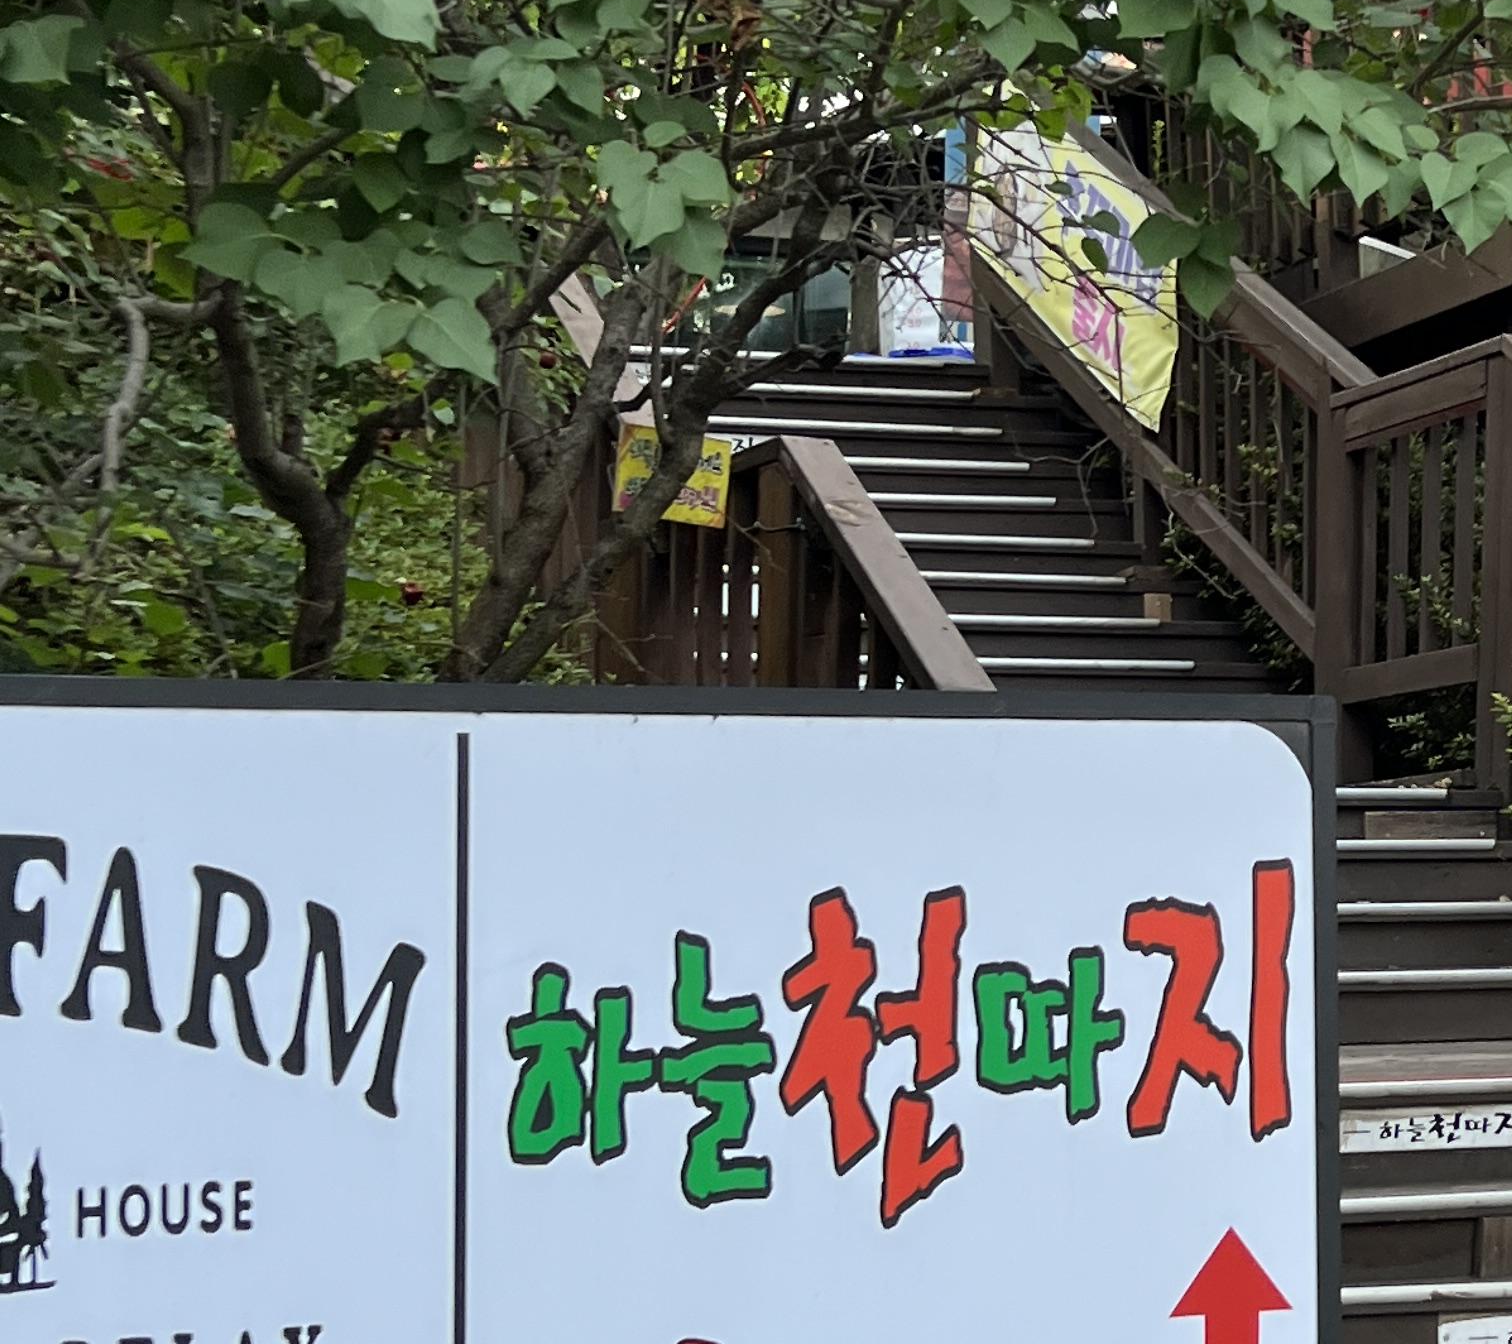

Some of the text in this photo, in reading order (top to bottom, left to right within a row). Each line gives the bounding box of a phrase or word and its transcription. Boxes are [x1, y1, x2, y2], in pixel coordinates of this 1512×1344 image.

[0, 833, 427, 1119] FARM
[506, 858, 1295, 1228] 하늘천따지
[77, 1179, 254, 1239] HOUSE
